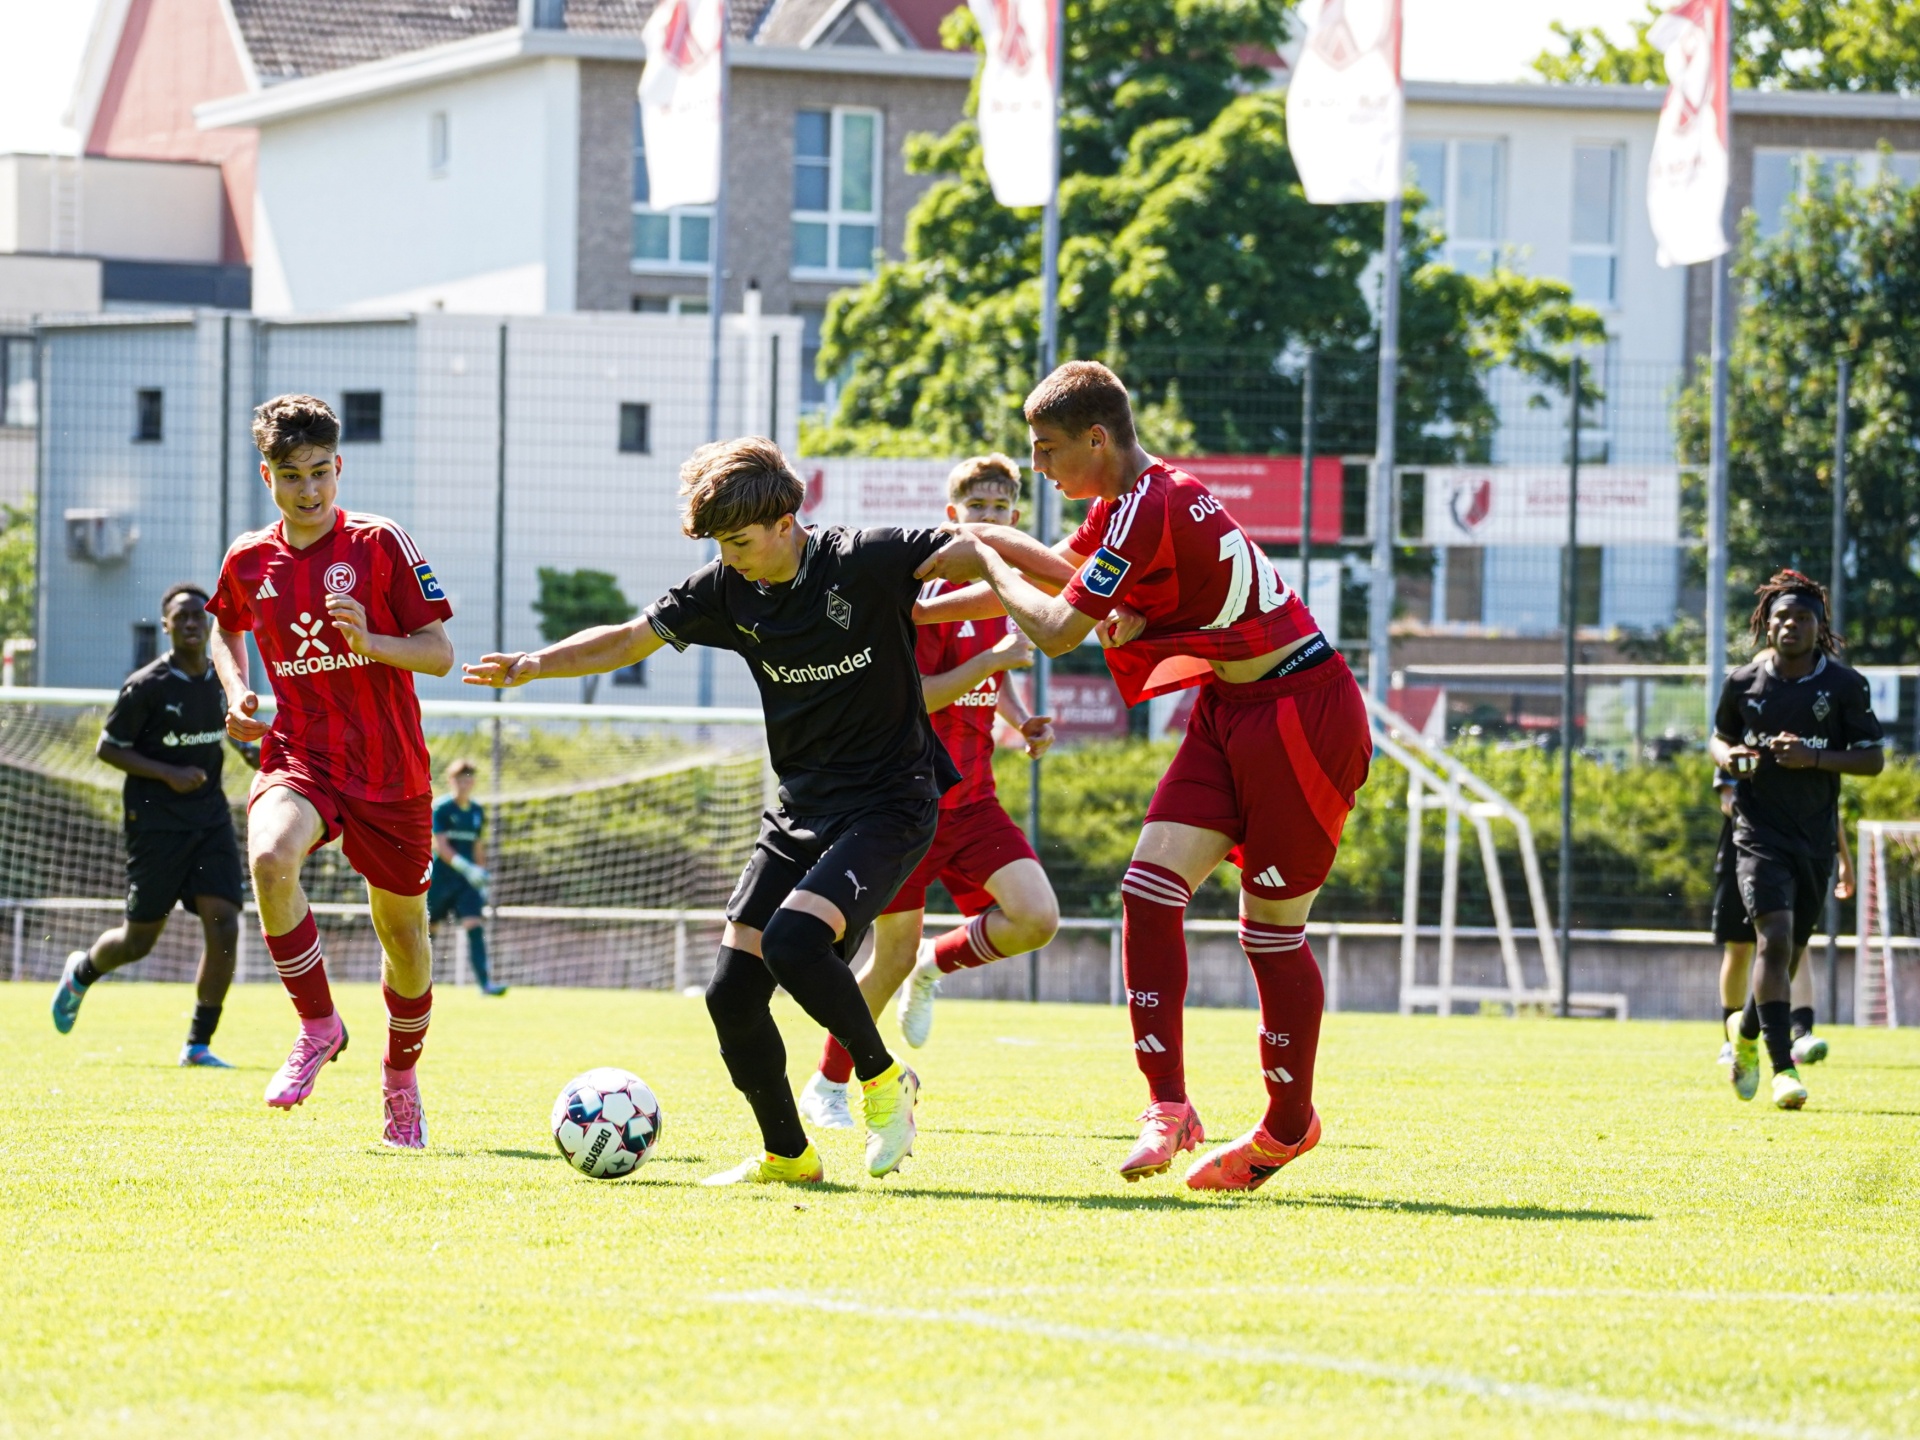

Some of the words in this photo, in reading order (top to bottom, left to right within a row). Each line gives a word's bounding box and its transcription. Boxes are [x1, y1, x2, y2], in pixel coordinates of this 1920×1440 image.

[1088, 568, 1113, 587] Chef
[778, 646, 873, 684] Santander
[1277, 658, 1299, 678] JACK
[1303, 640, 1325, 657] JONES
[180, 729, 227, 746] Santan
[1757, 732, 1829, 749] Sander
